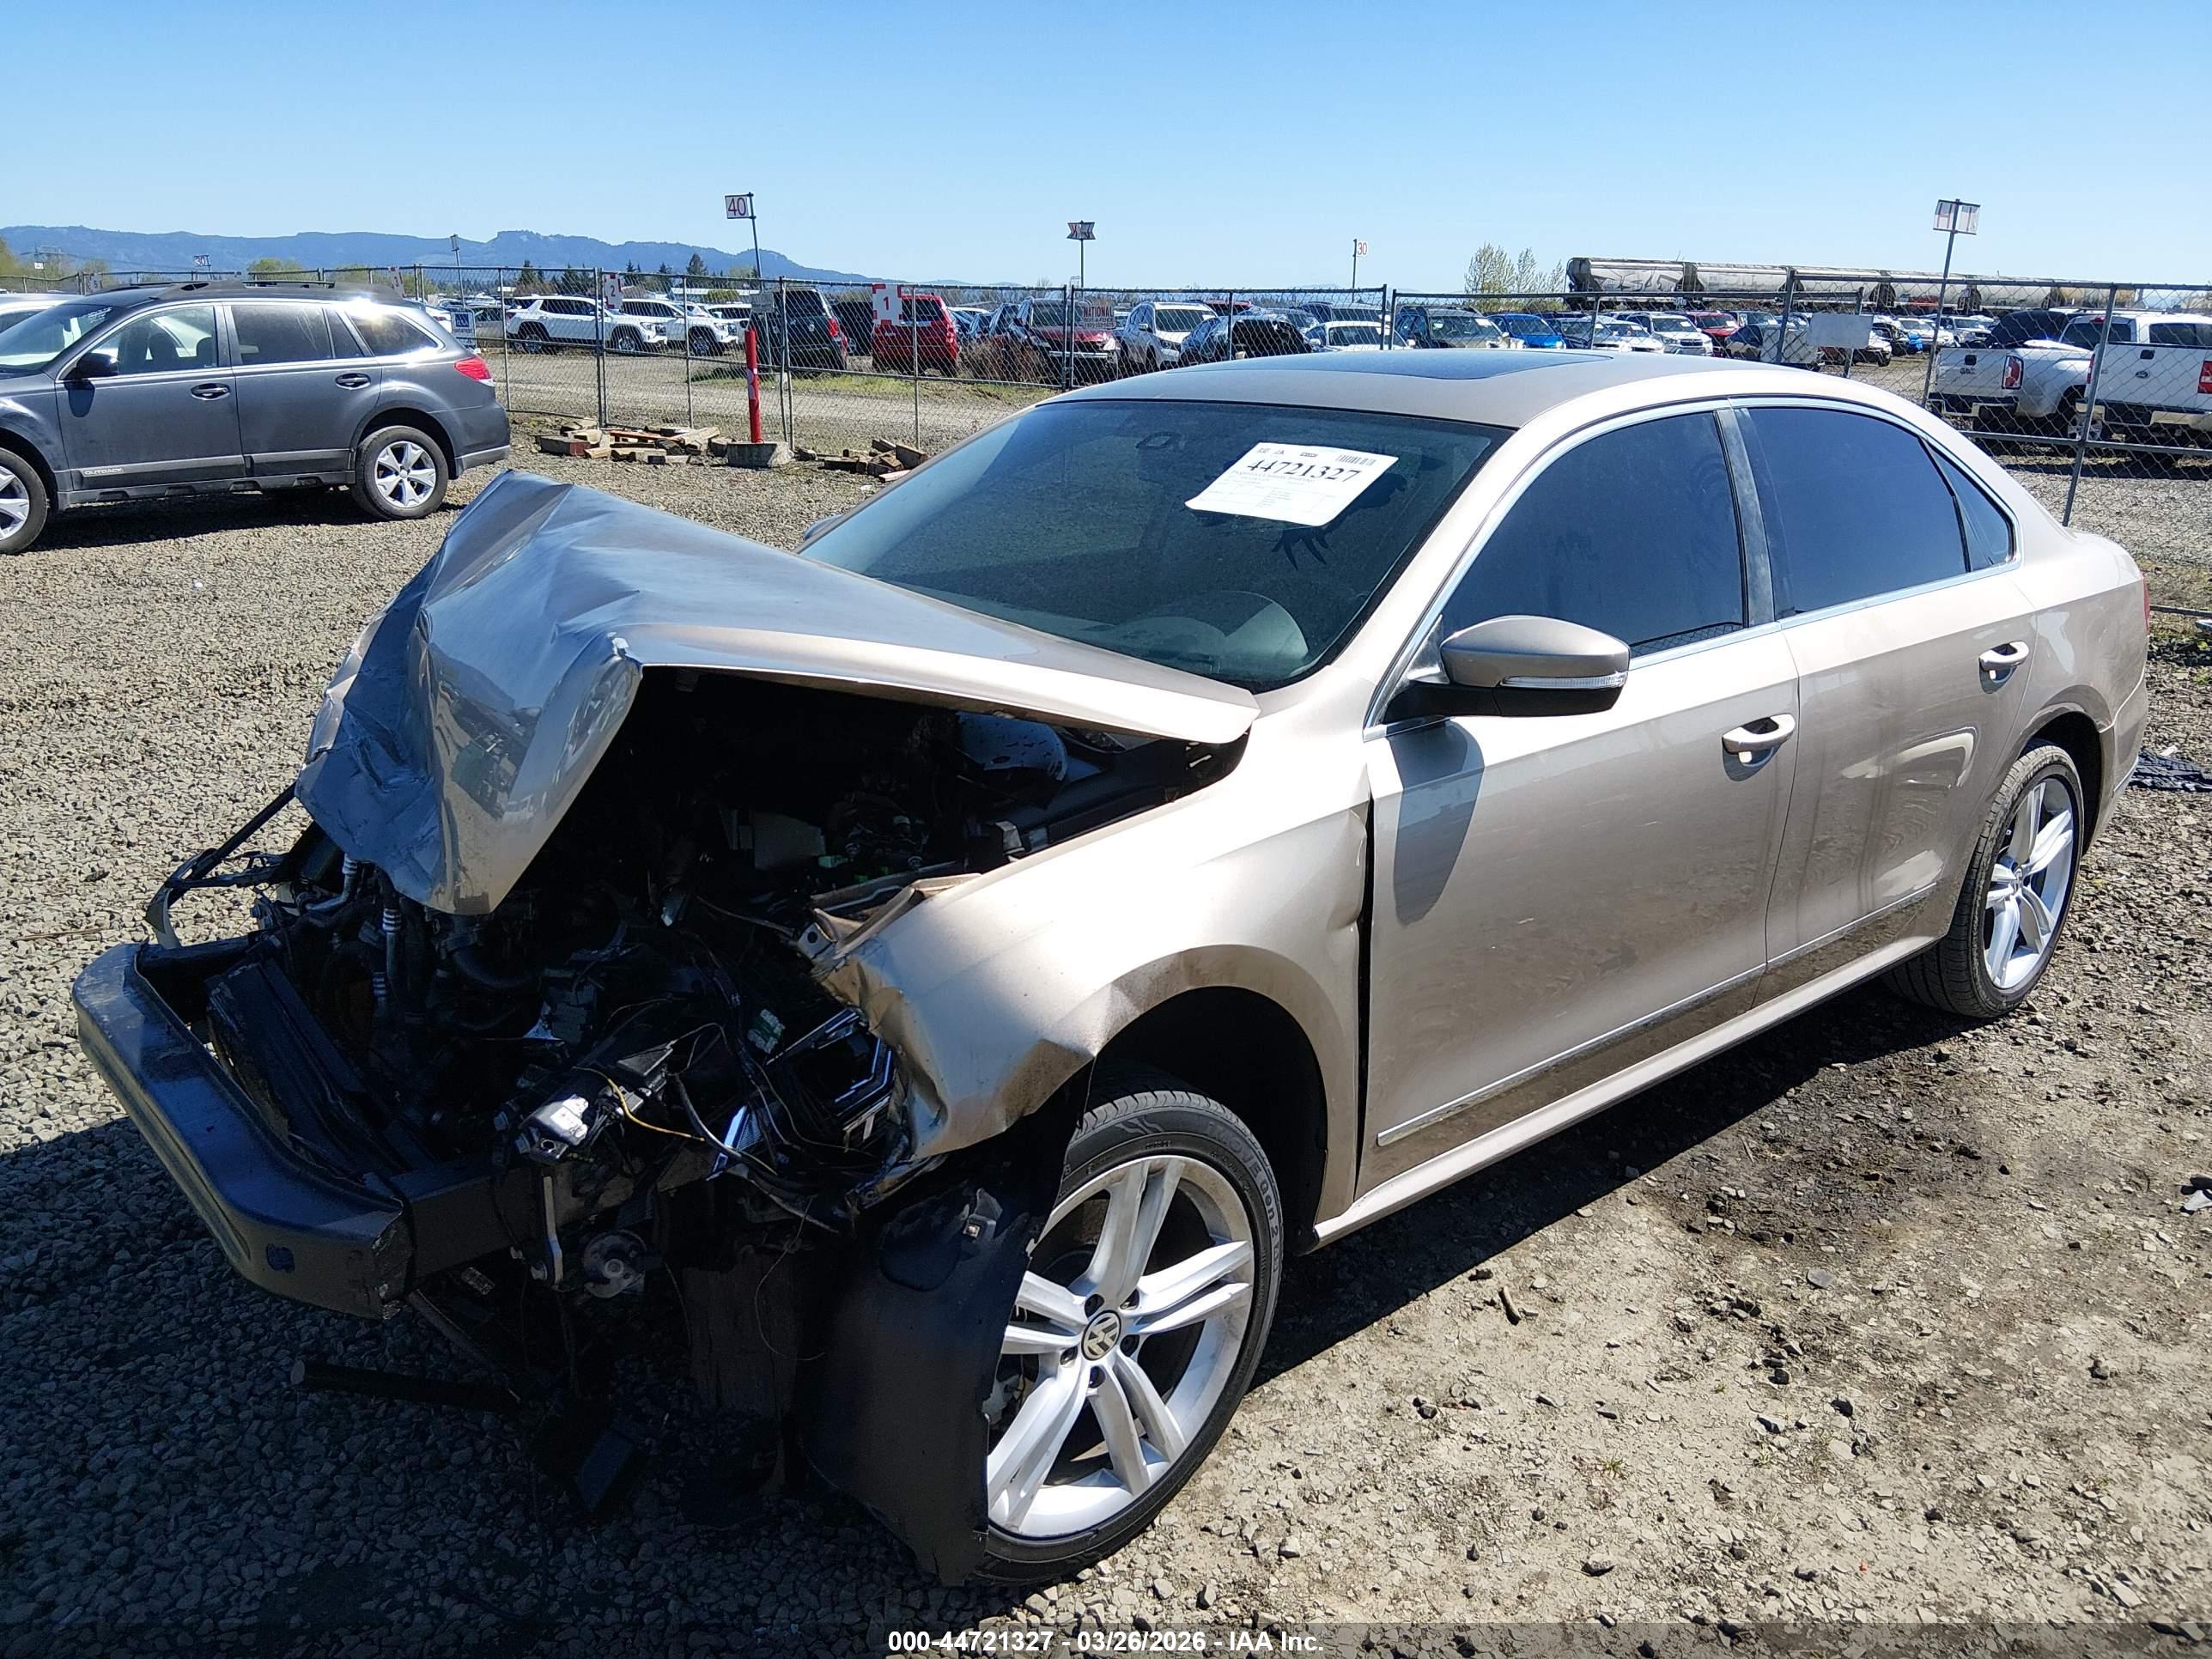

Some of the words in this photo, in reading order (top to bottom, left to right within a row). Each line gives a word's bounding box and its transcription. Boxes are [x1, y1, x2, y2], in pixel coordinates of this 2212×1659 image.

[727, 197, 746, 216] 40
[1357, 241, 1368, 256] 30
[610, 284, 616, 297] 2
[883, 295, 890, 311] 1
[1084, 306, 1114, 318] NATIONAL
[84, 467, 125, 476] OUTBACK
[1247, 458, 1364, 483] 44721327
